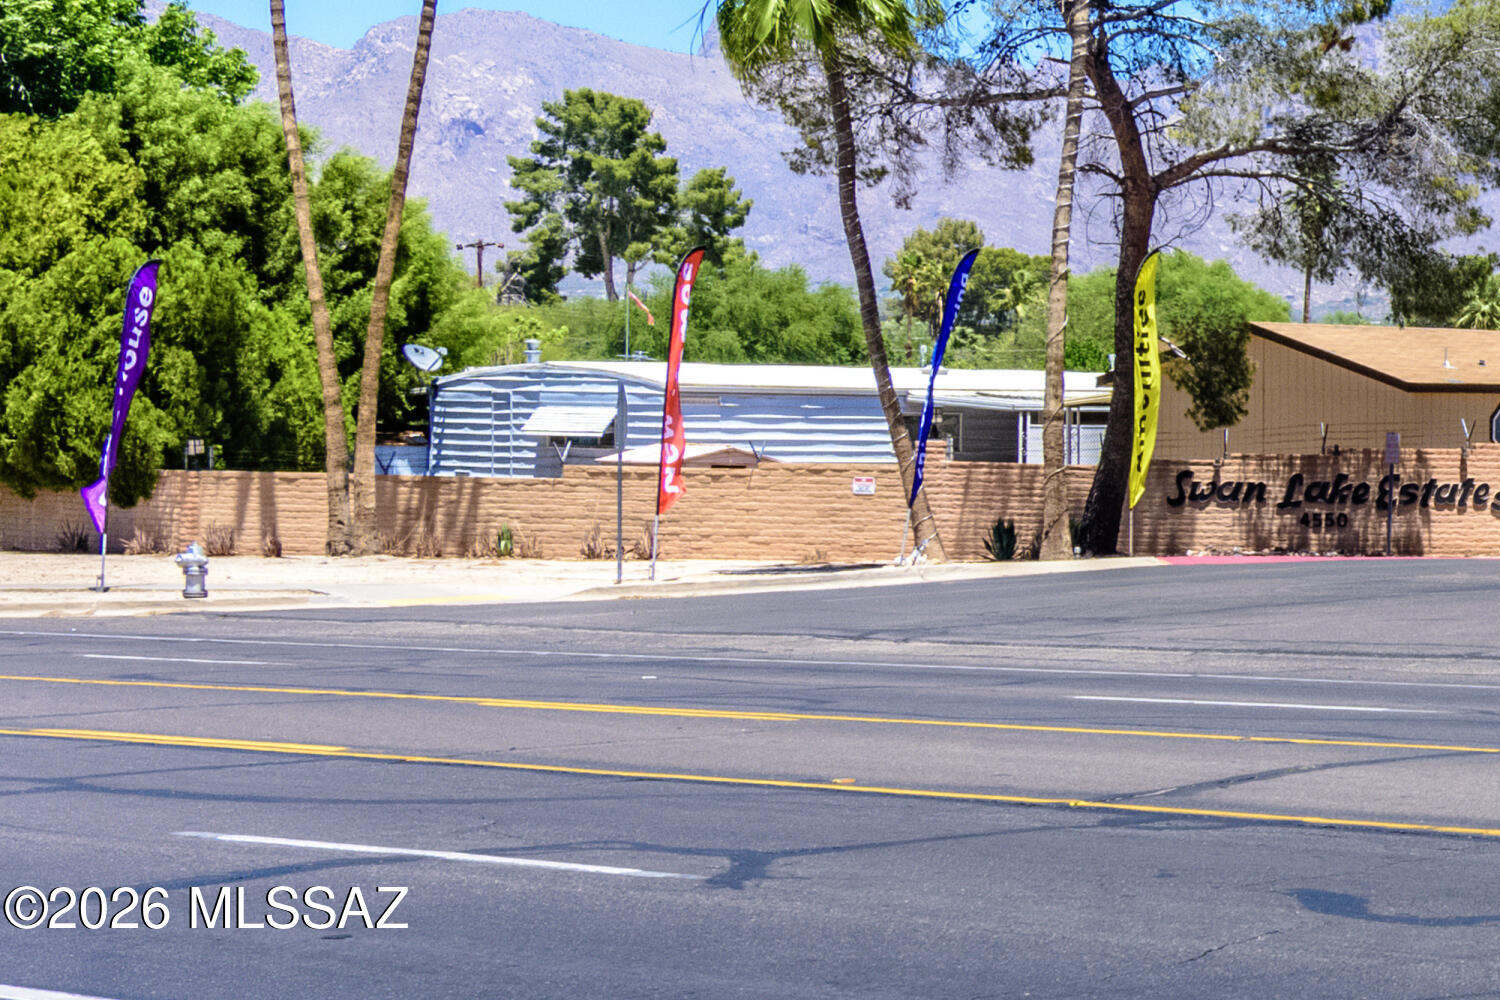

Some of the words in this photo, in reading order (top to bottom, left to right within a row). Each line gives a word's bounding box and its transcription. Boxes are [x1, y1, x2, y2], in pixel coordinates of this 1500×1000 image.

[1167, 470, 1267, 508] Swan
[1277, 473, 1370, 509] Lake
[1300, 511, 1348, 529] 4550
